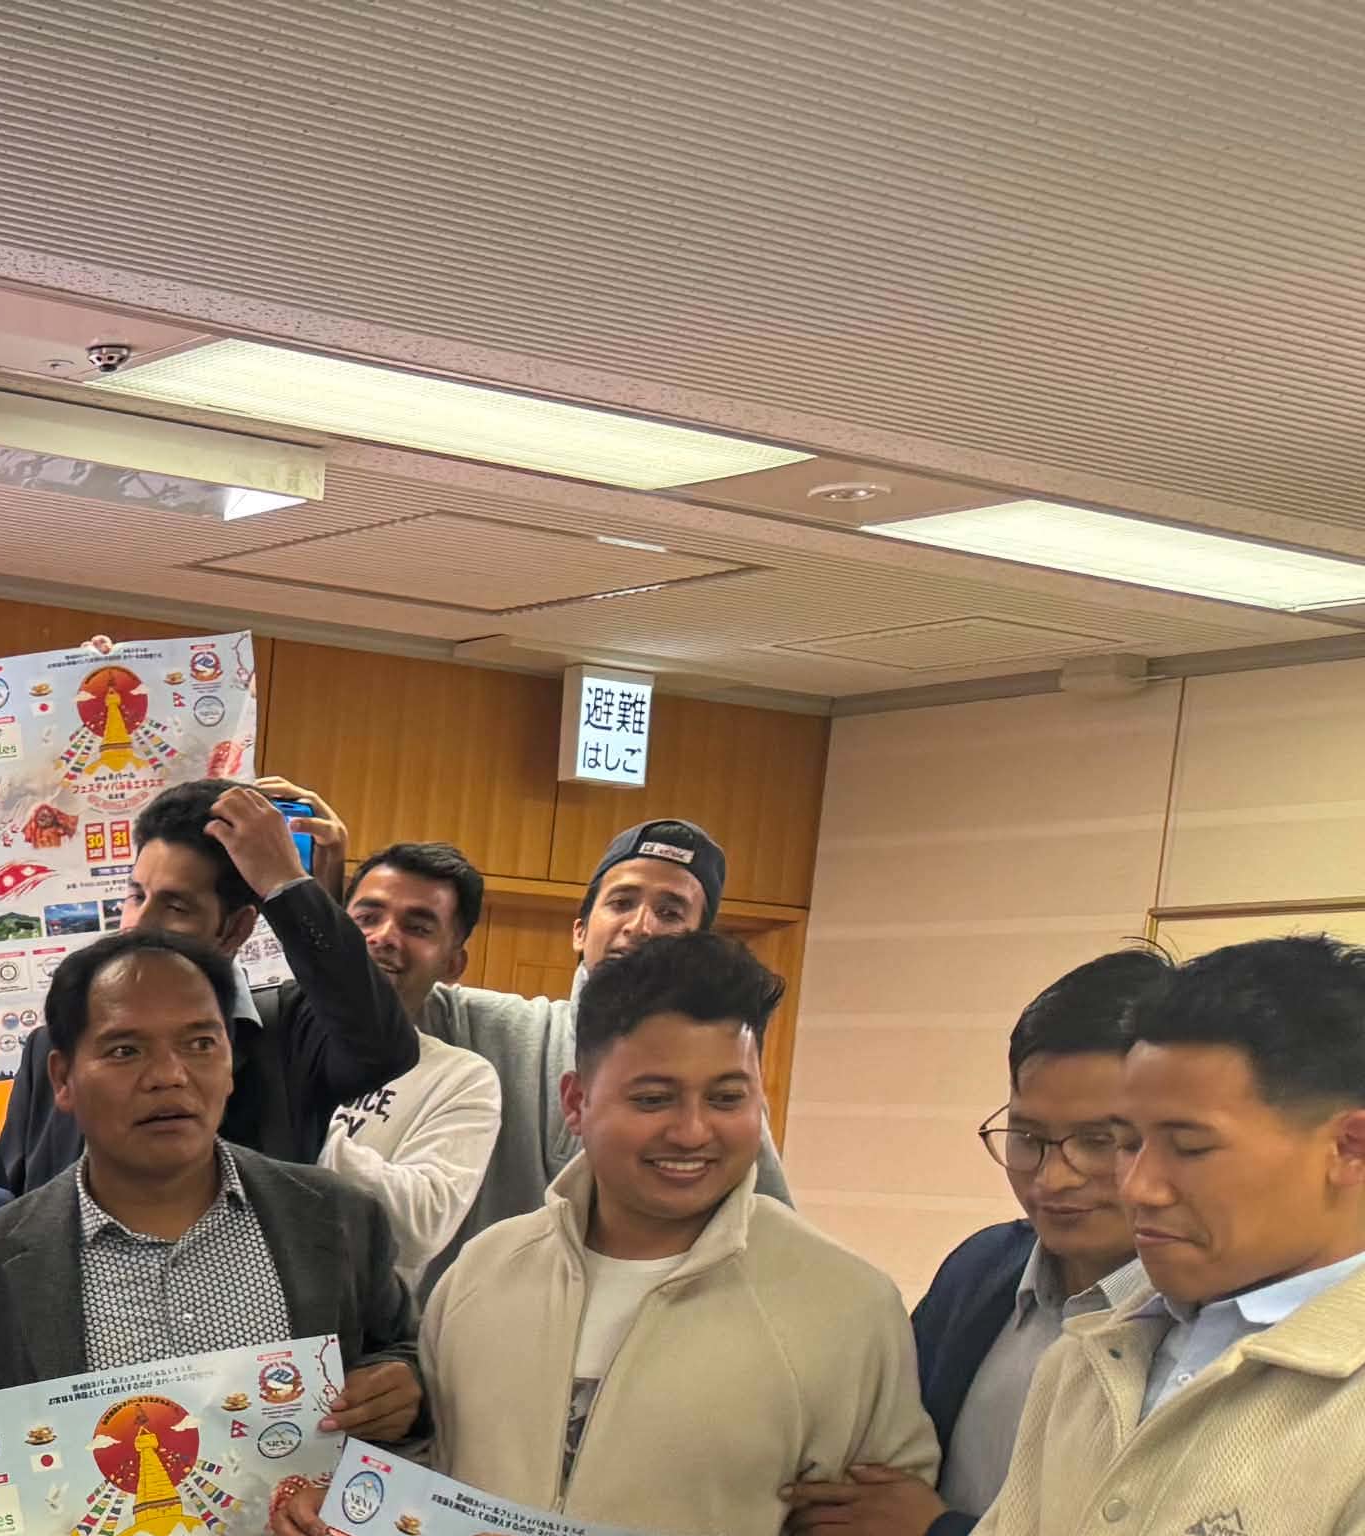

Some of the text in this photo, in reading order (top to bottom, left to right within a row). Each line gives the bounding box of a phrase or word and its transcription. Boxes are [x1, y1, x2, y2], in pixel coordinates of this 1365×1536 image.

[584, 688, 646, 734] 避難
[583, 742, 642, 773] はしご
